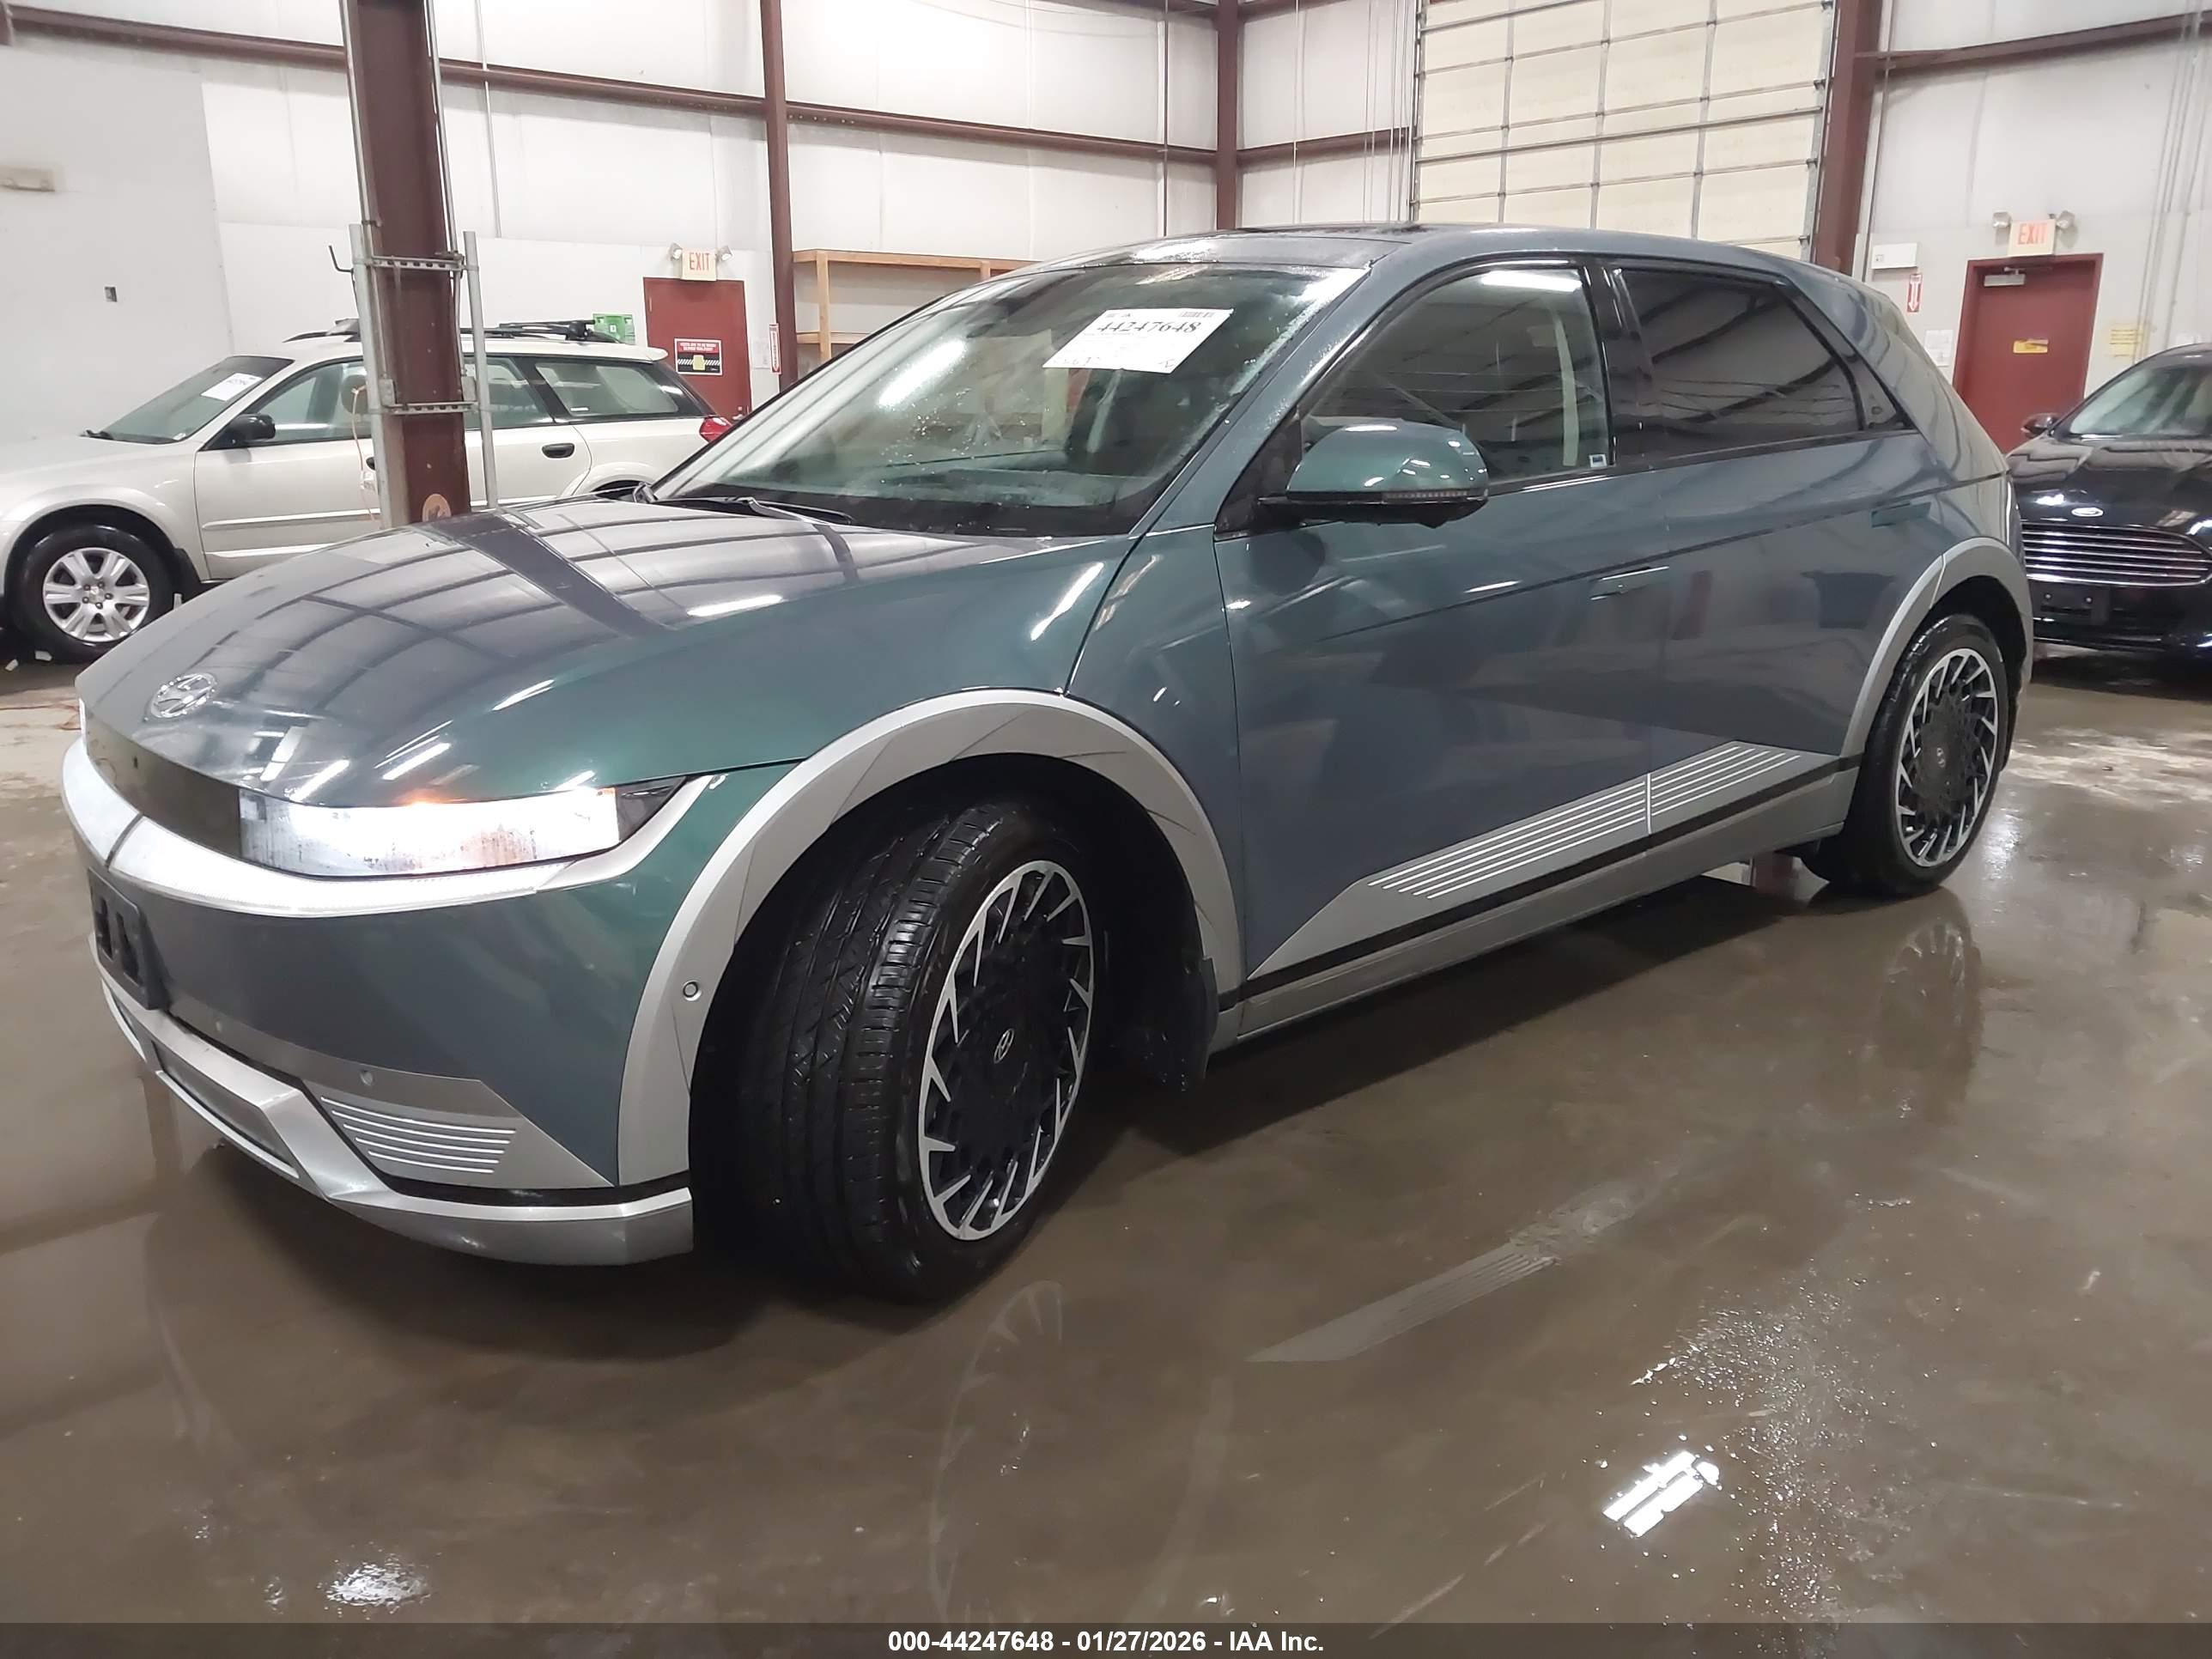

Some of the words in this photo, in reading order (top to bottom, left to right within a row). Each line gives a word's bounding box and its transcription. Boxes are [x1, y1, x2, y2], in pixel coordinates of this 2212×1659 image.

[2018, 223, 2047, 245] EXIT
[689, 252, 710, 270] EXIT
[1097, 320, 1202, 333] 44247648
